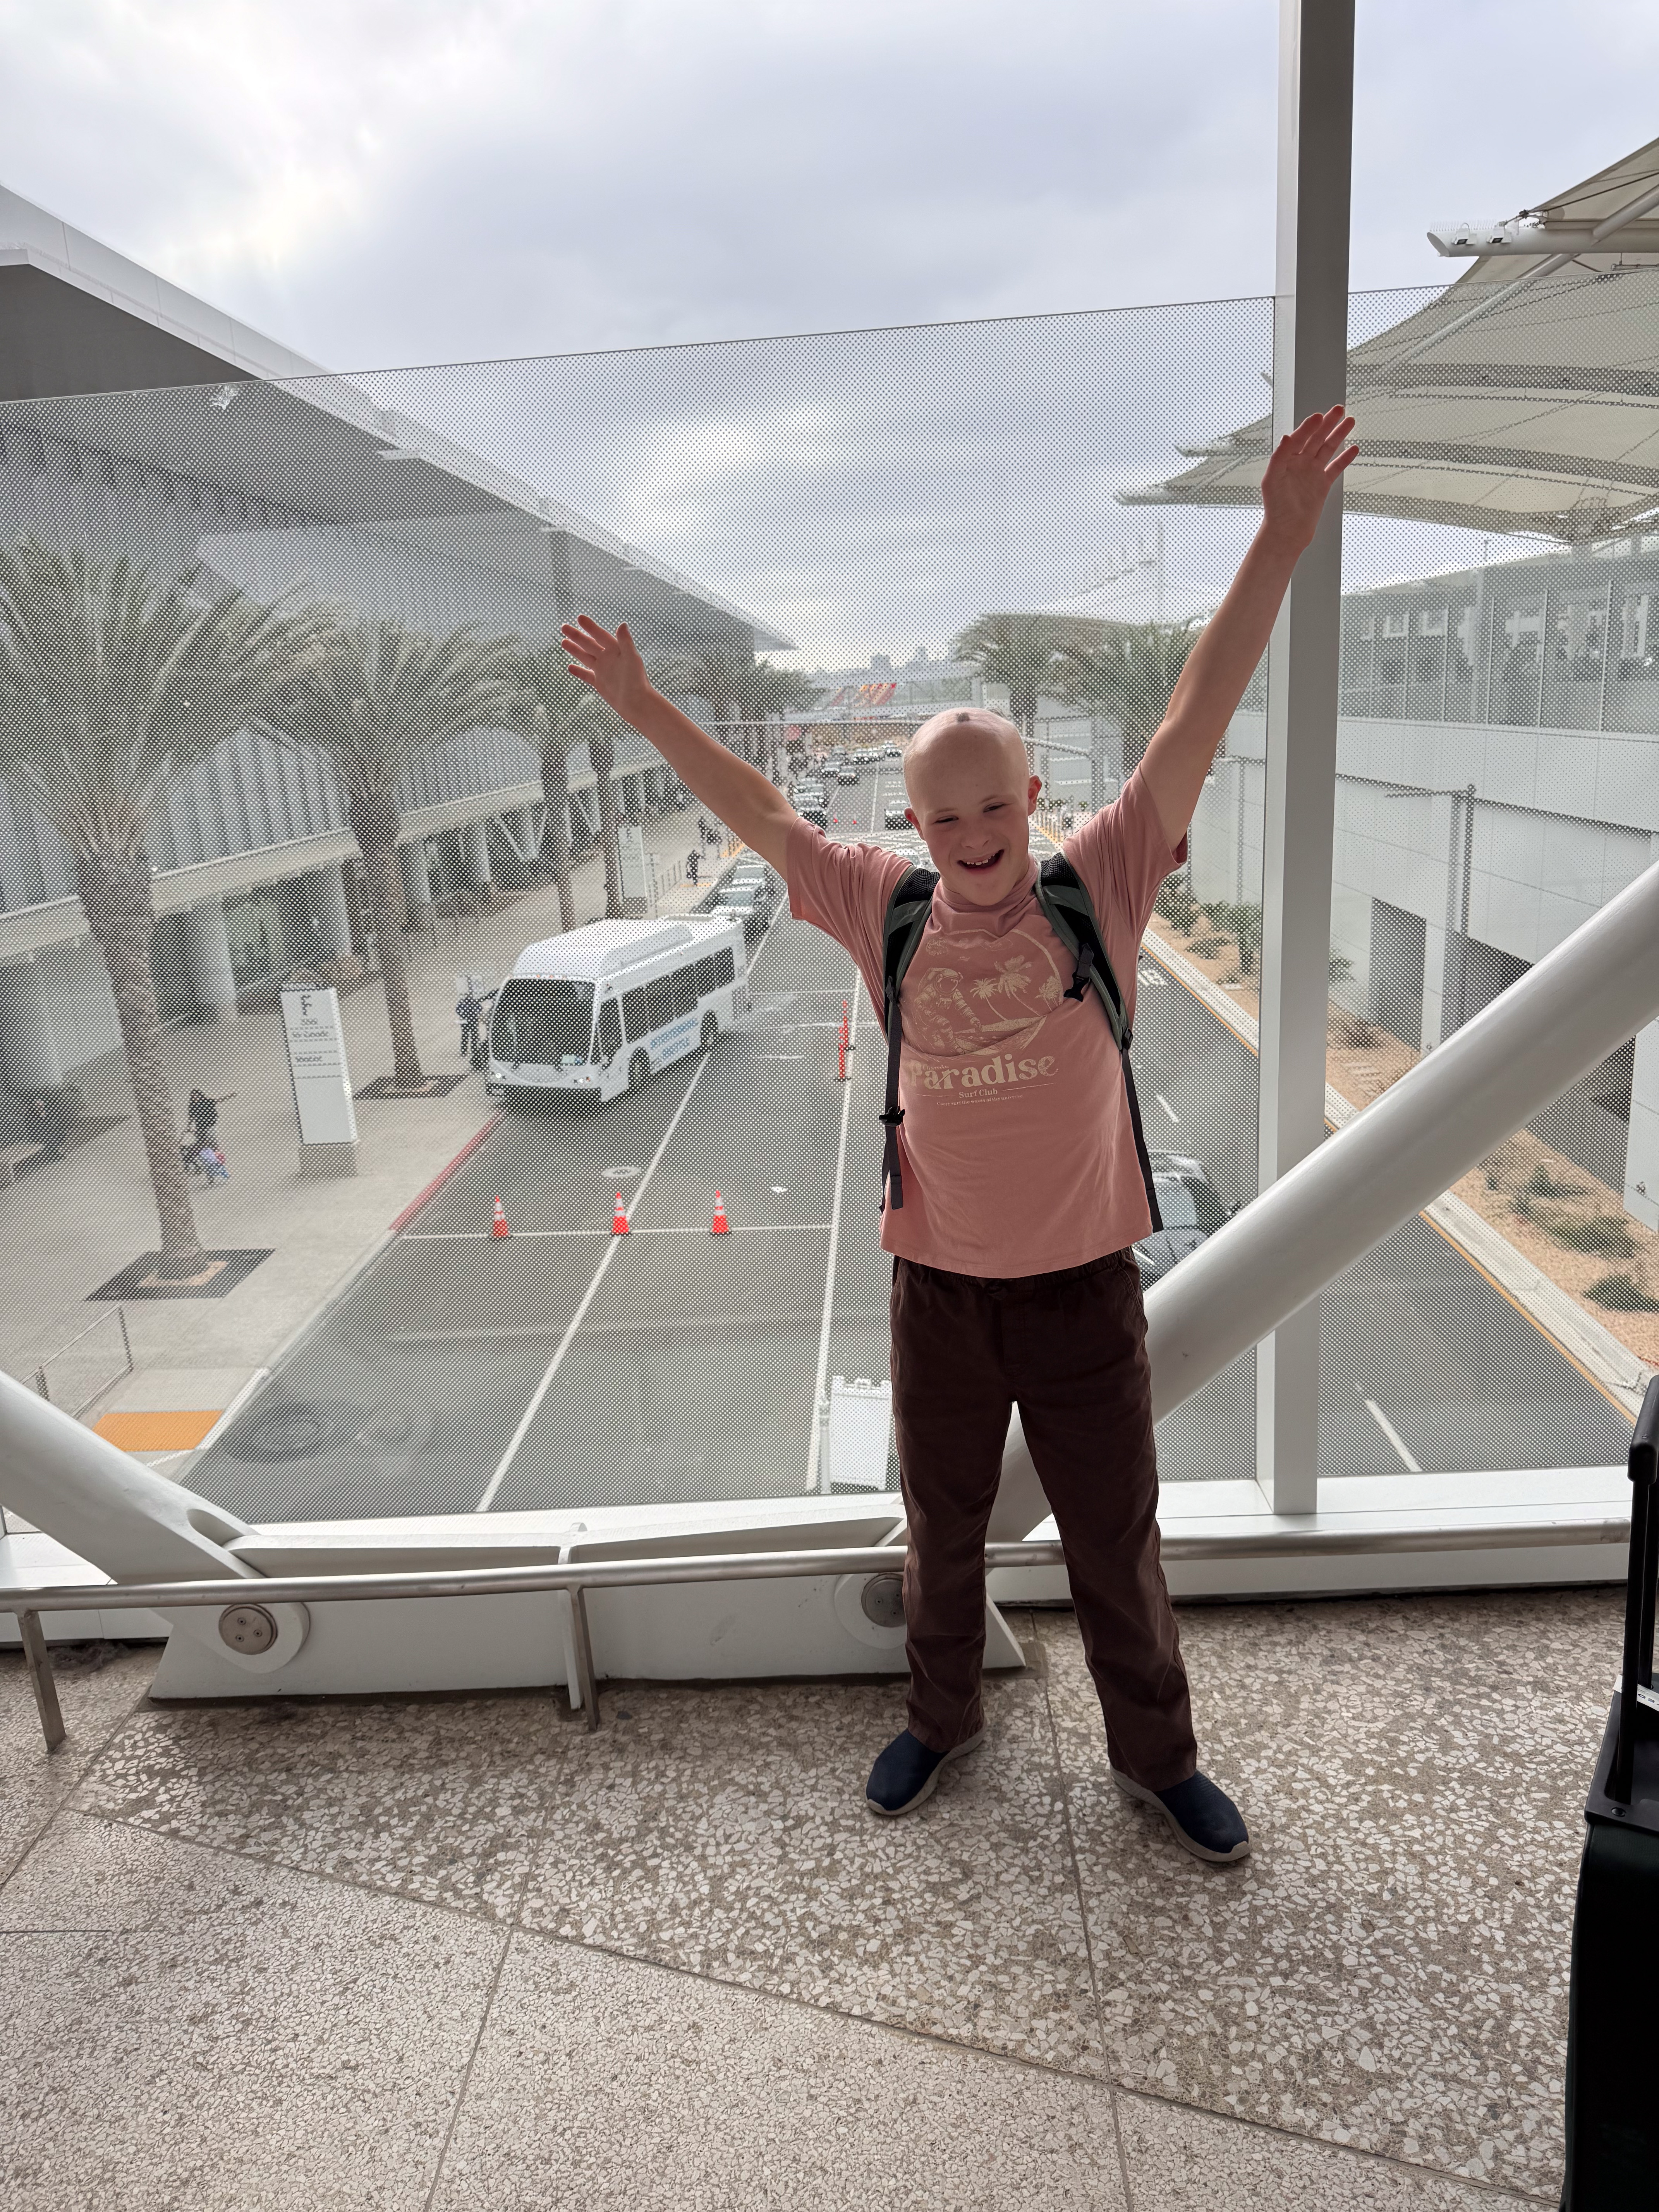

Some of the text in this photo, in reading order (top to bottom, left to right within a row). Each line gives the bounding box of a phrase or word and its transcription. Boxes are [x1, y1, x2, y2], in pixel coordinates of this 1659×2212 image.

[301, 994, 312, 1015] F
[907, 1053, 1059, 1090] Paradise
[958, 1090, 978, 1098] Surf
